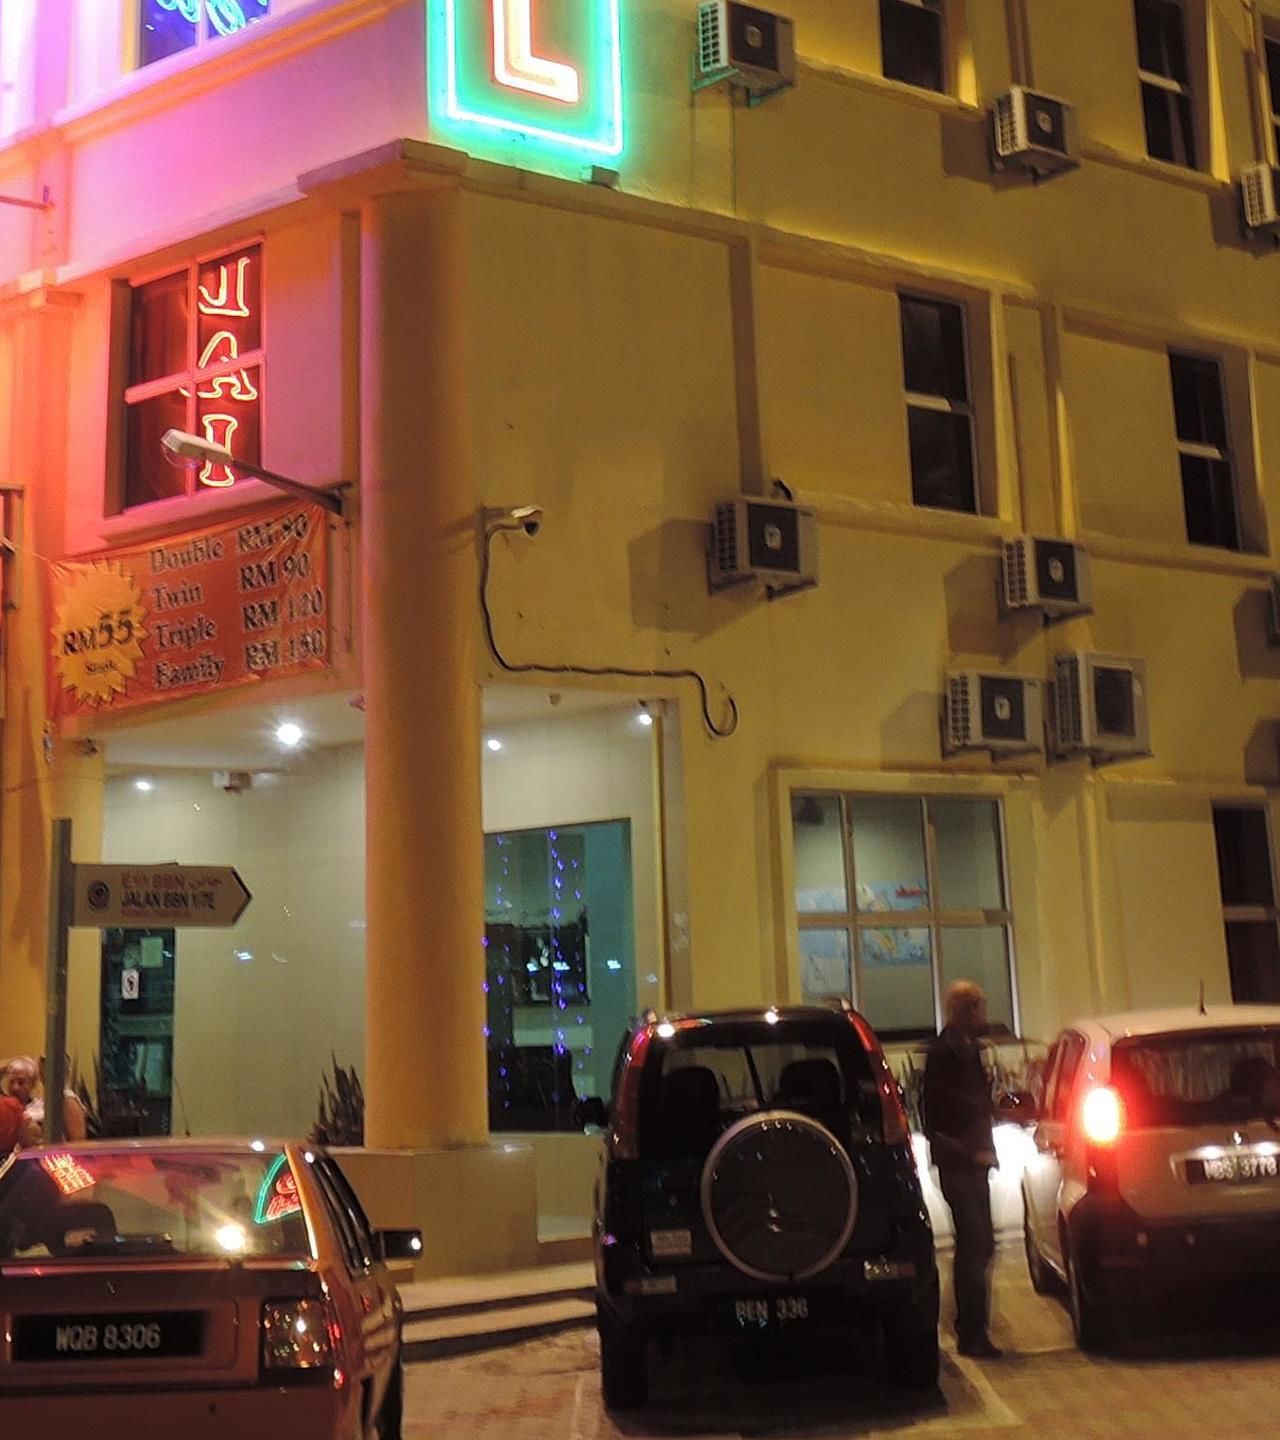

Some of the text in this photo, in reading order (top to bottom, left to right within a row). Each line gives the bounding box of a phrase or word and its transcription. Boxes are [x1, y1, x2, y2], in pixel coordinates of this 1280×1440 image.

[150, 537, 224, 574] Double
[151, 552, 310, 611] Twin RM 90
[151, 586, 325, 652] Triple RM 120
[153, 654, 225, 690] Family
[244, 638, 281, 671] RM
[120, 890, 160, 909] JALAN
[56, 1322, 161, 1353] WQB 8306
